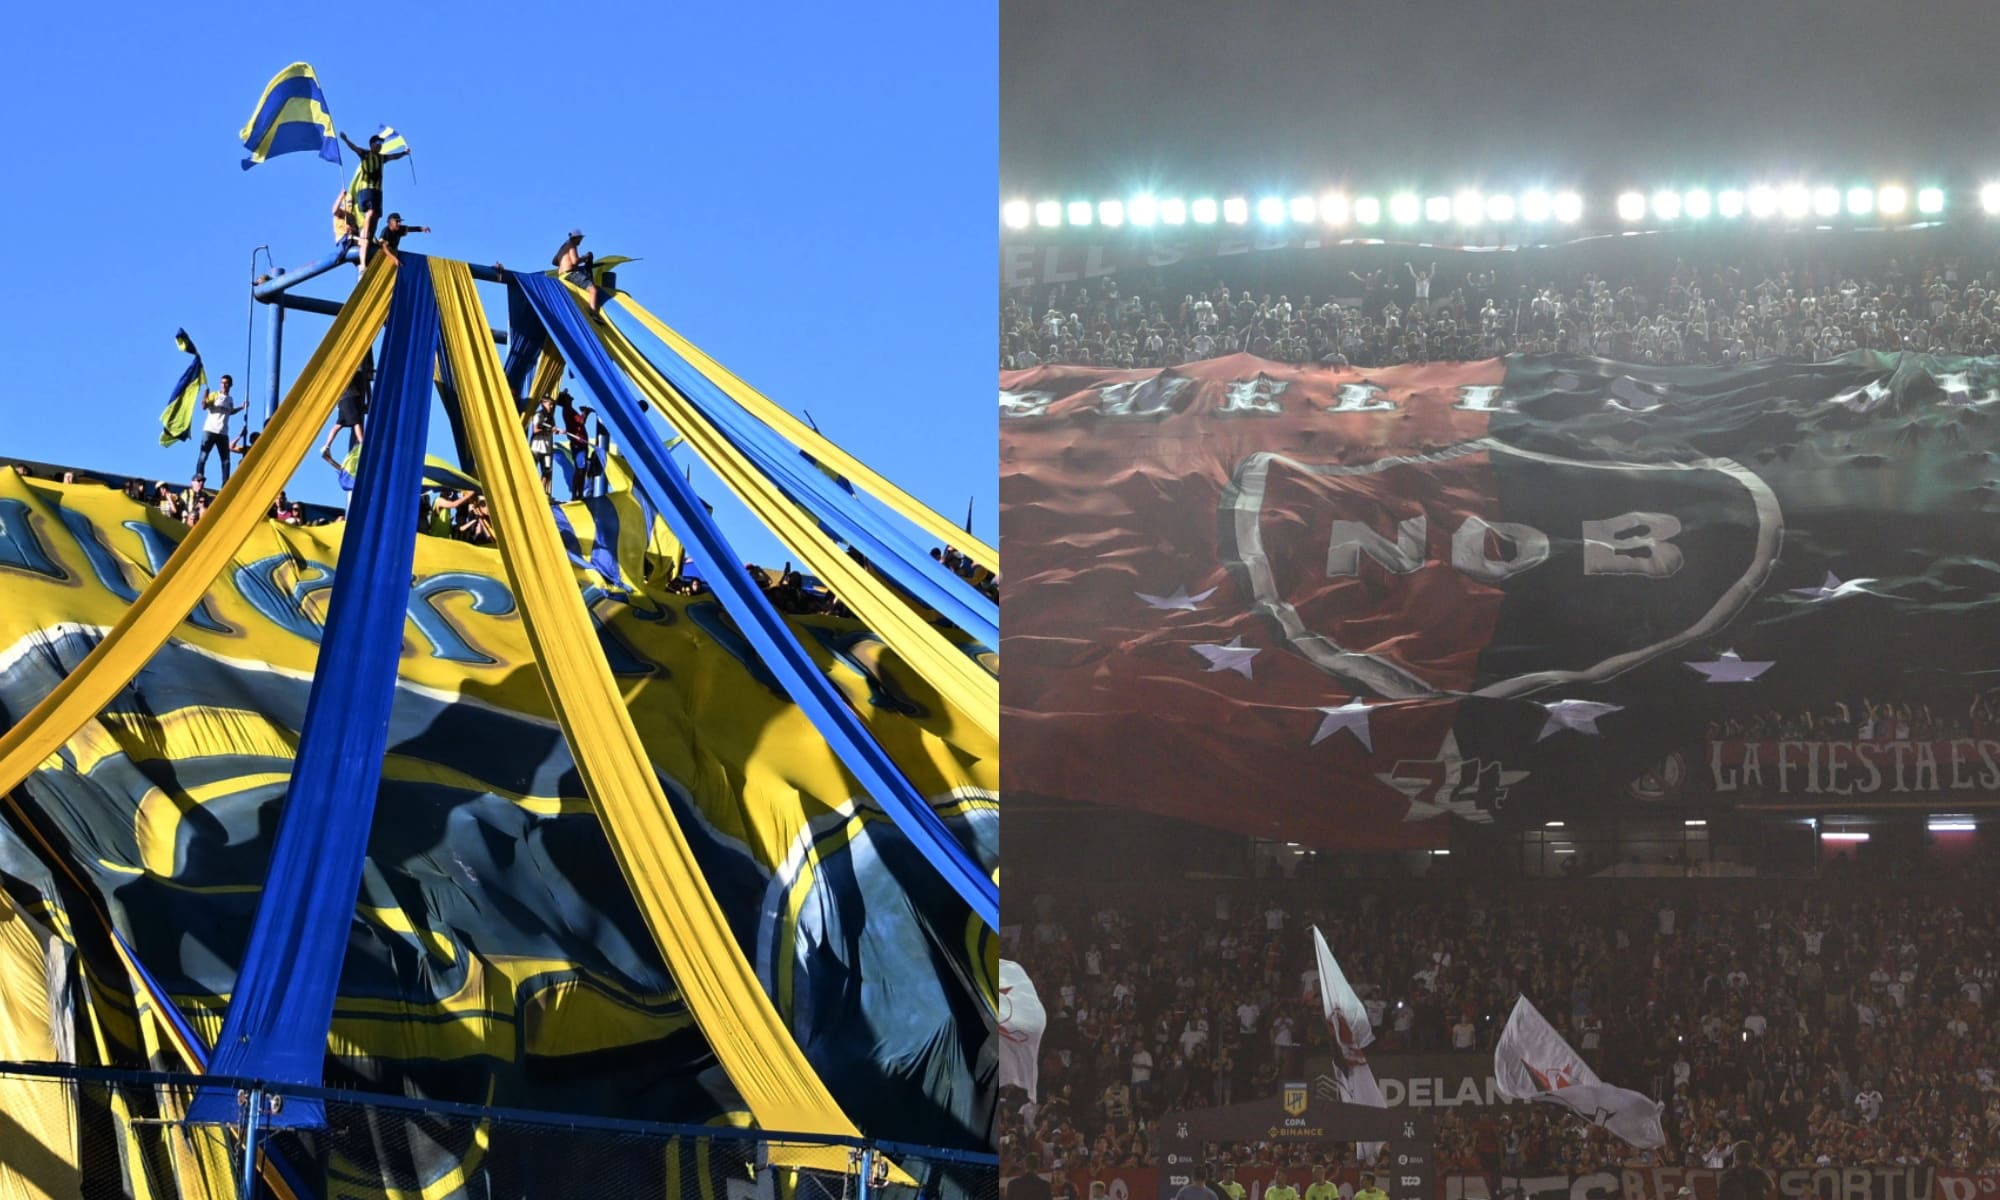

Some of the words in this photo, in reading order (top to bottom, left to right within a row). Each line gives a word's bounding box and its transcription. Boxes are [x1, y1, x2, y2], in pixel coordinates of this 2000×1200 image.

[1710, 740, 1763, 792] LA
[1777, 739, 1941, 796] FIESTA
[1284, 1117, 1306, 1127] COPA
[1280, 1128, 1325, 1137] BINANCE
